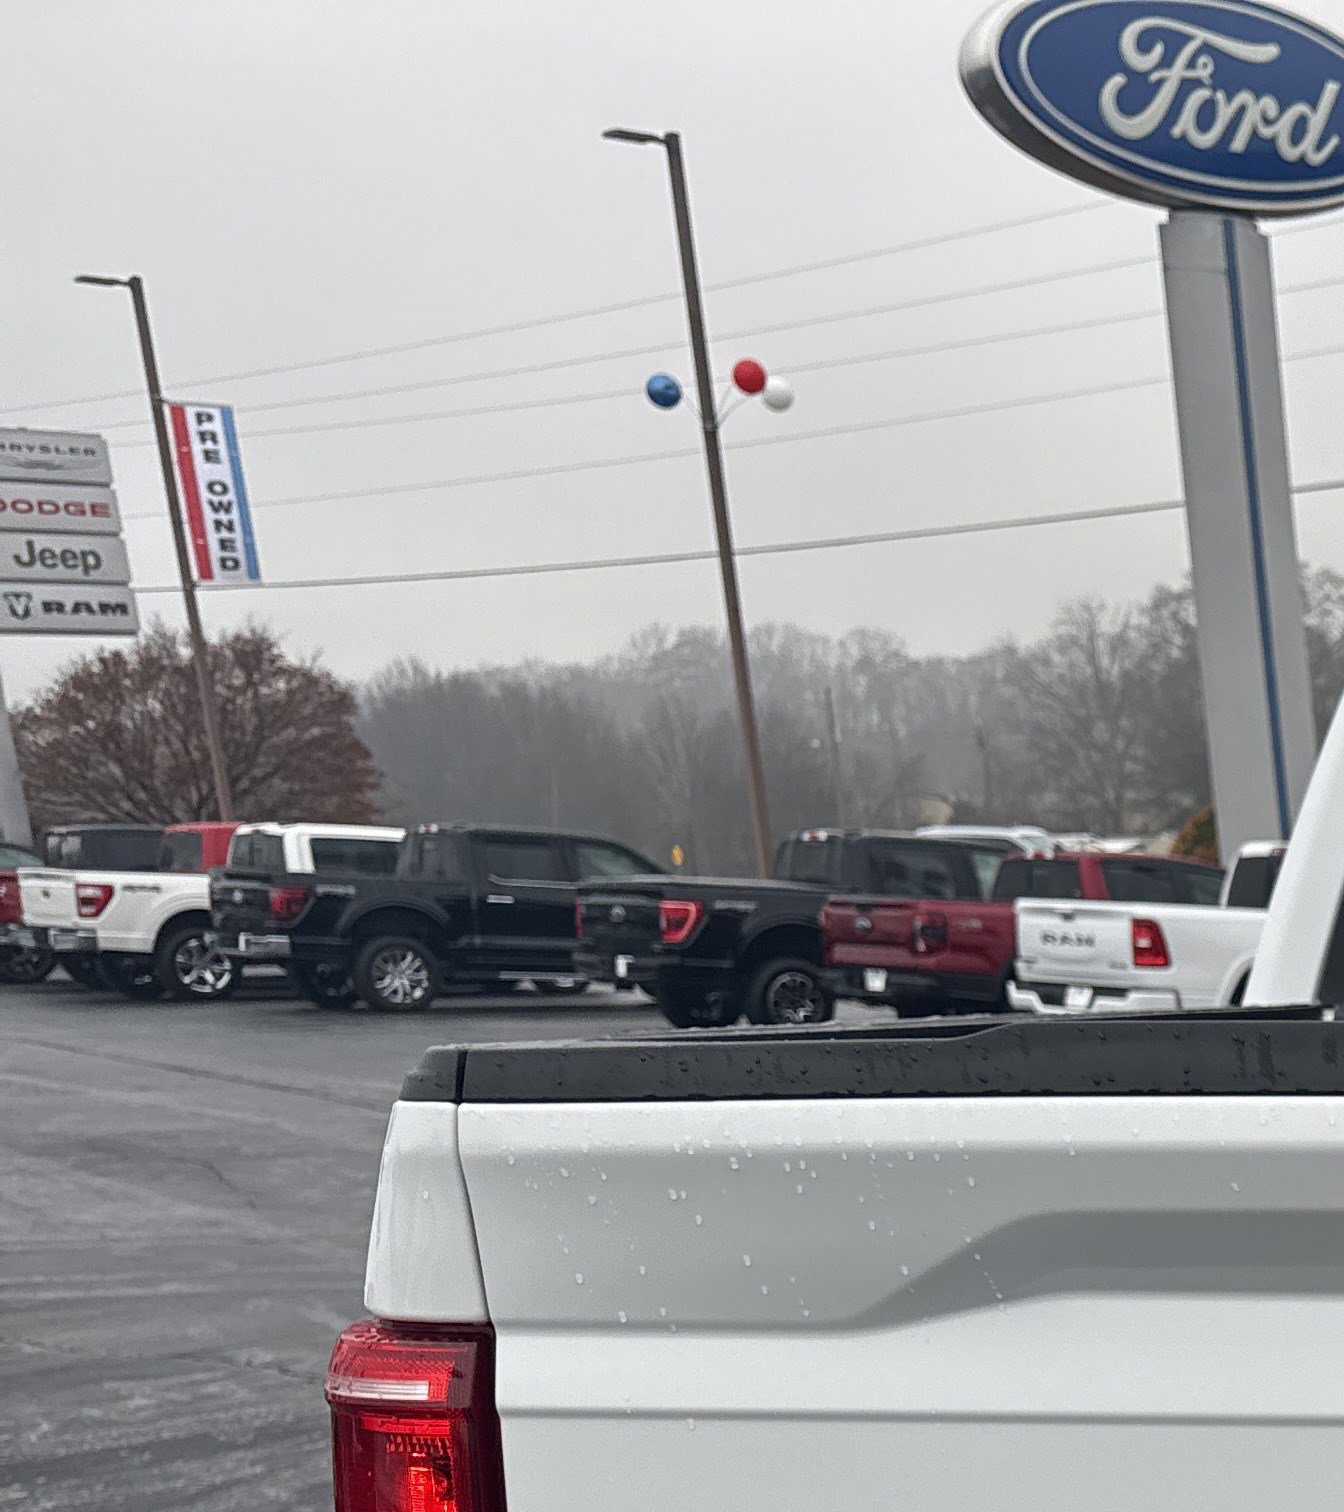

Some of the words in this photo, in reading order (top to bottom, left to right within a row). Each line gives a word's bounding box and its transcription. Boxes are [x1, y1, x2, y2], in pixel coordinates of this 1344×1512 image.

[1099, 16, 1342, 167] Ford
[195, 410, 220, 465] PRE
[206, 480, 241, 572] OWNED
[13, 538, 102, 577] Jeep
[42, 601, 129, 616] RAM
